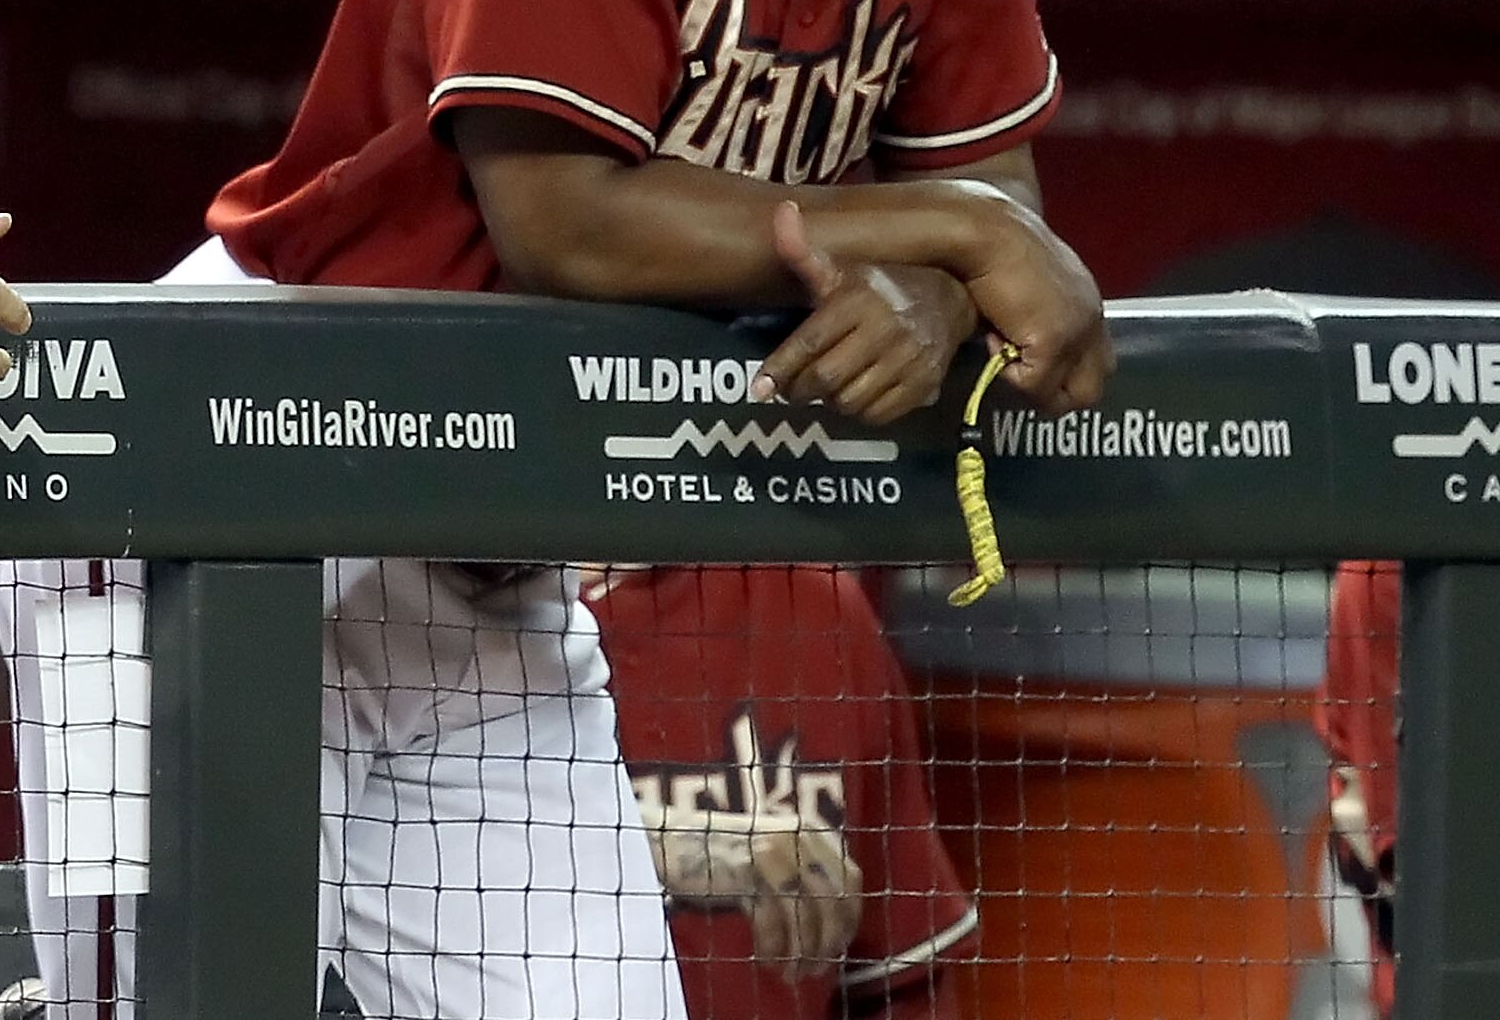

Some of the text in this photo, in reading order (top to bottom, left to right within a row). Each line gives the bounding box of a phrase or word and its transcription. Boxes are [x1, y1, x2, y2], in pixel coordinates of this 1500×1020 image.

[1353, 341, 1500, 405] LONE
[208, 397, 517, 450] WinGilaRiver.com
[992, 409, 1293, 458] WinGilaRiver.com
[605, 473, 902, 504] HOTEL & CASINO
